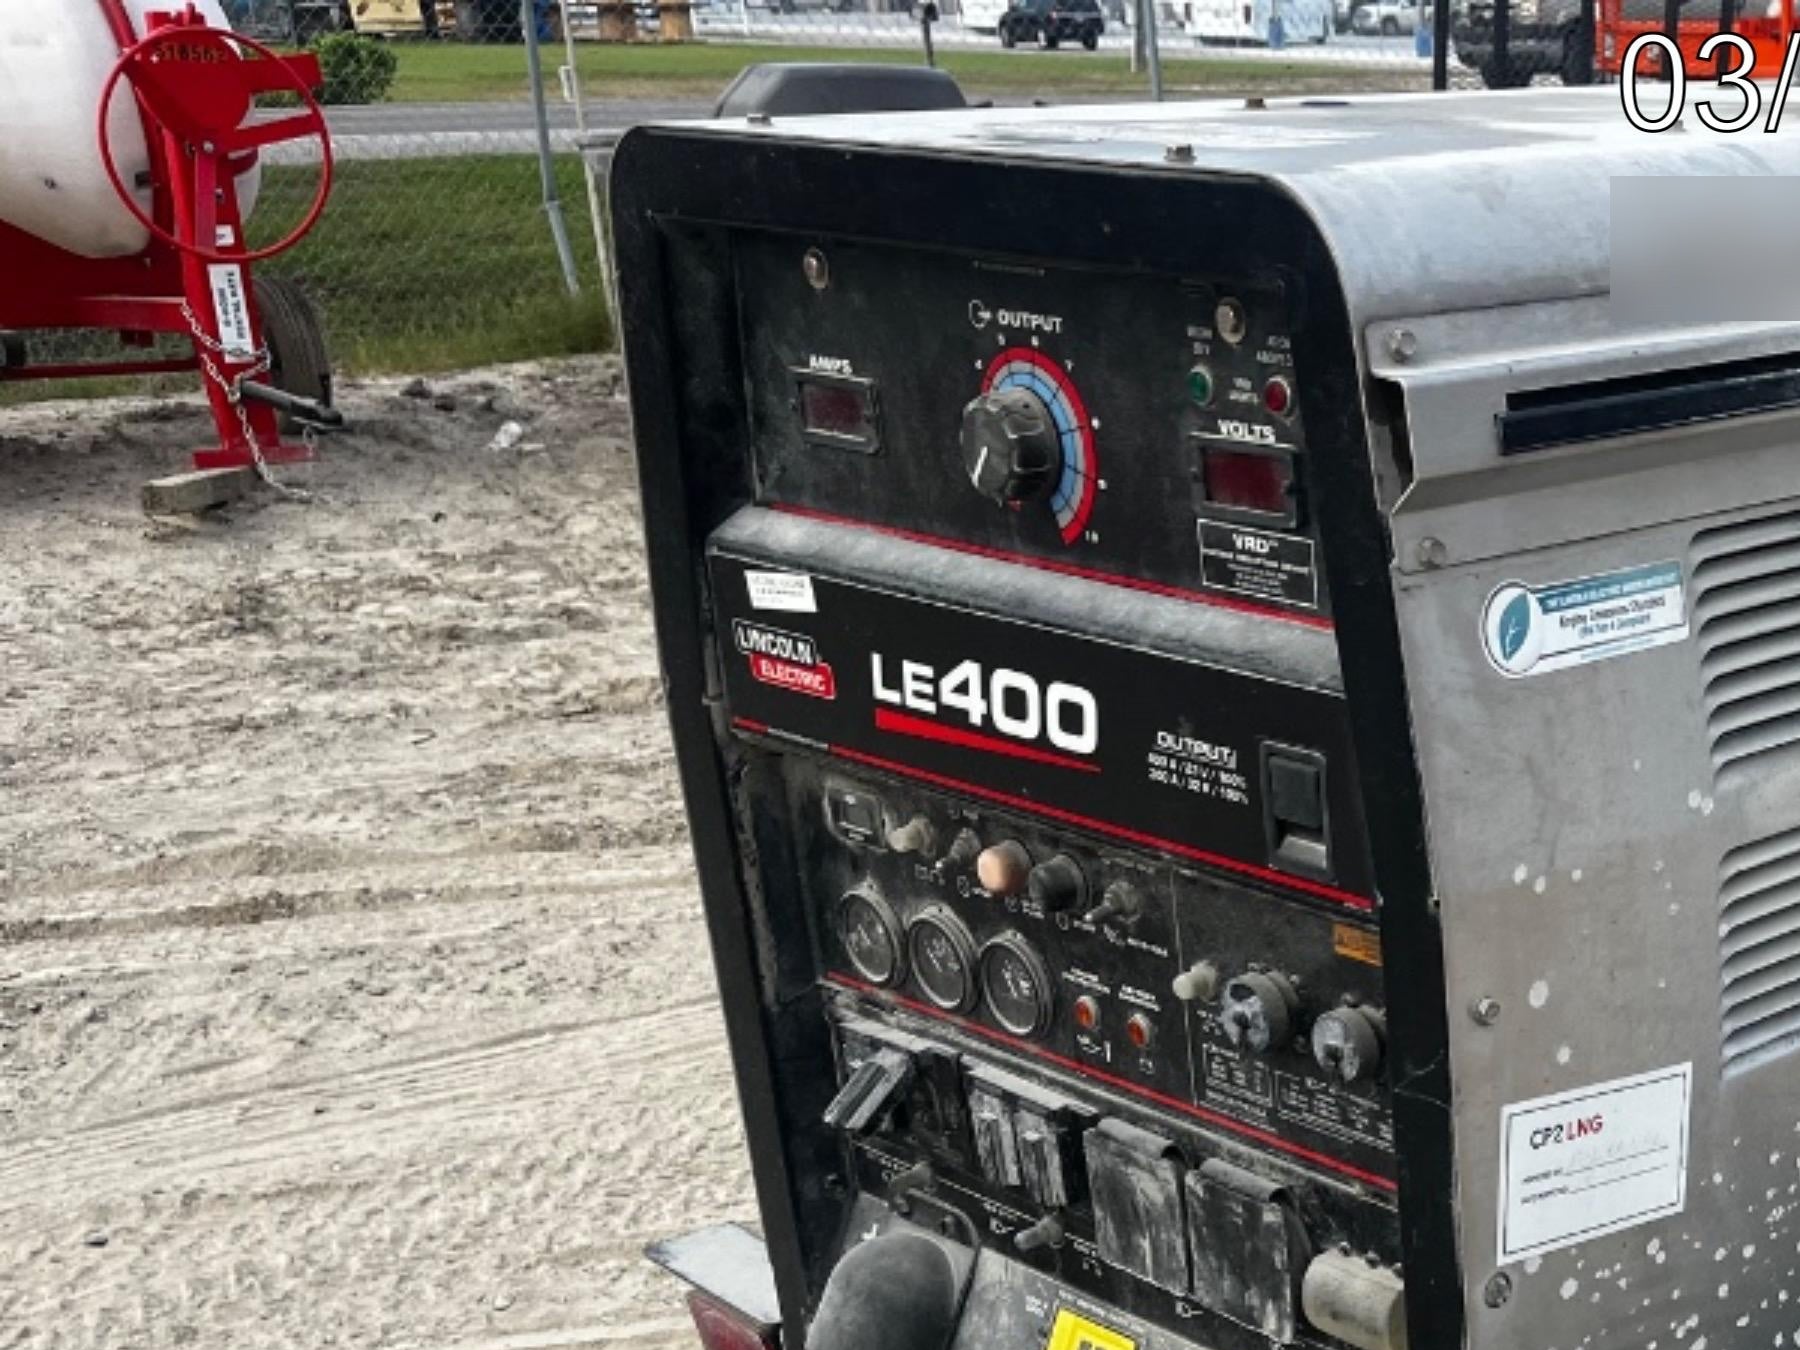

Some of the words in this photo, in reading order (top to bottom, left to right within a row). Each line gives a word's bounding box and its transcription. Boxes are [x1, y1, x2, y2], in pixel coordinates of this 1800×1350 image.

[998, 310, 1063, 335] OUTPUT
[1217, 419, 1276, 444] VOLTS
[737, 626, 814, 665] LINCOLN
[759, 659, 826, 692] ELECTRIC
[871, 652, 1098, 755] LE400
[1157, 731, 1232, 765] OUTPUT
[1566, 1114, 1604, 1142] LNG
